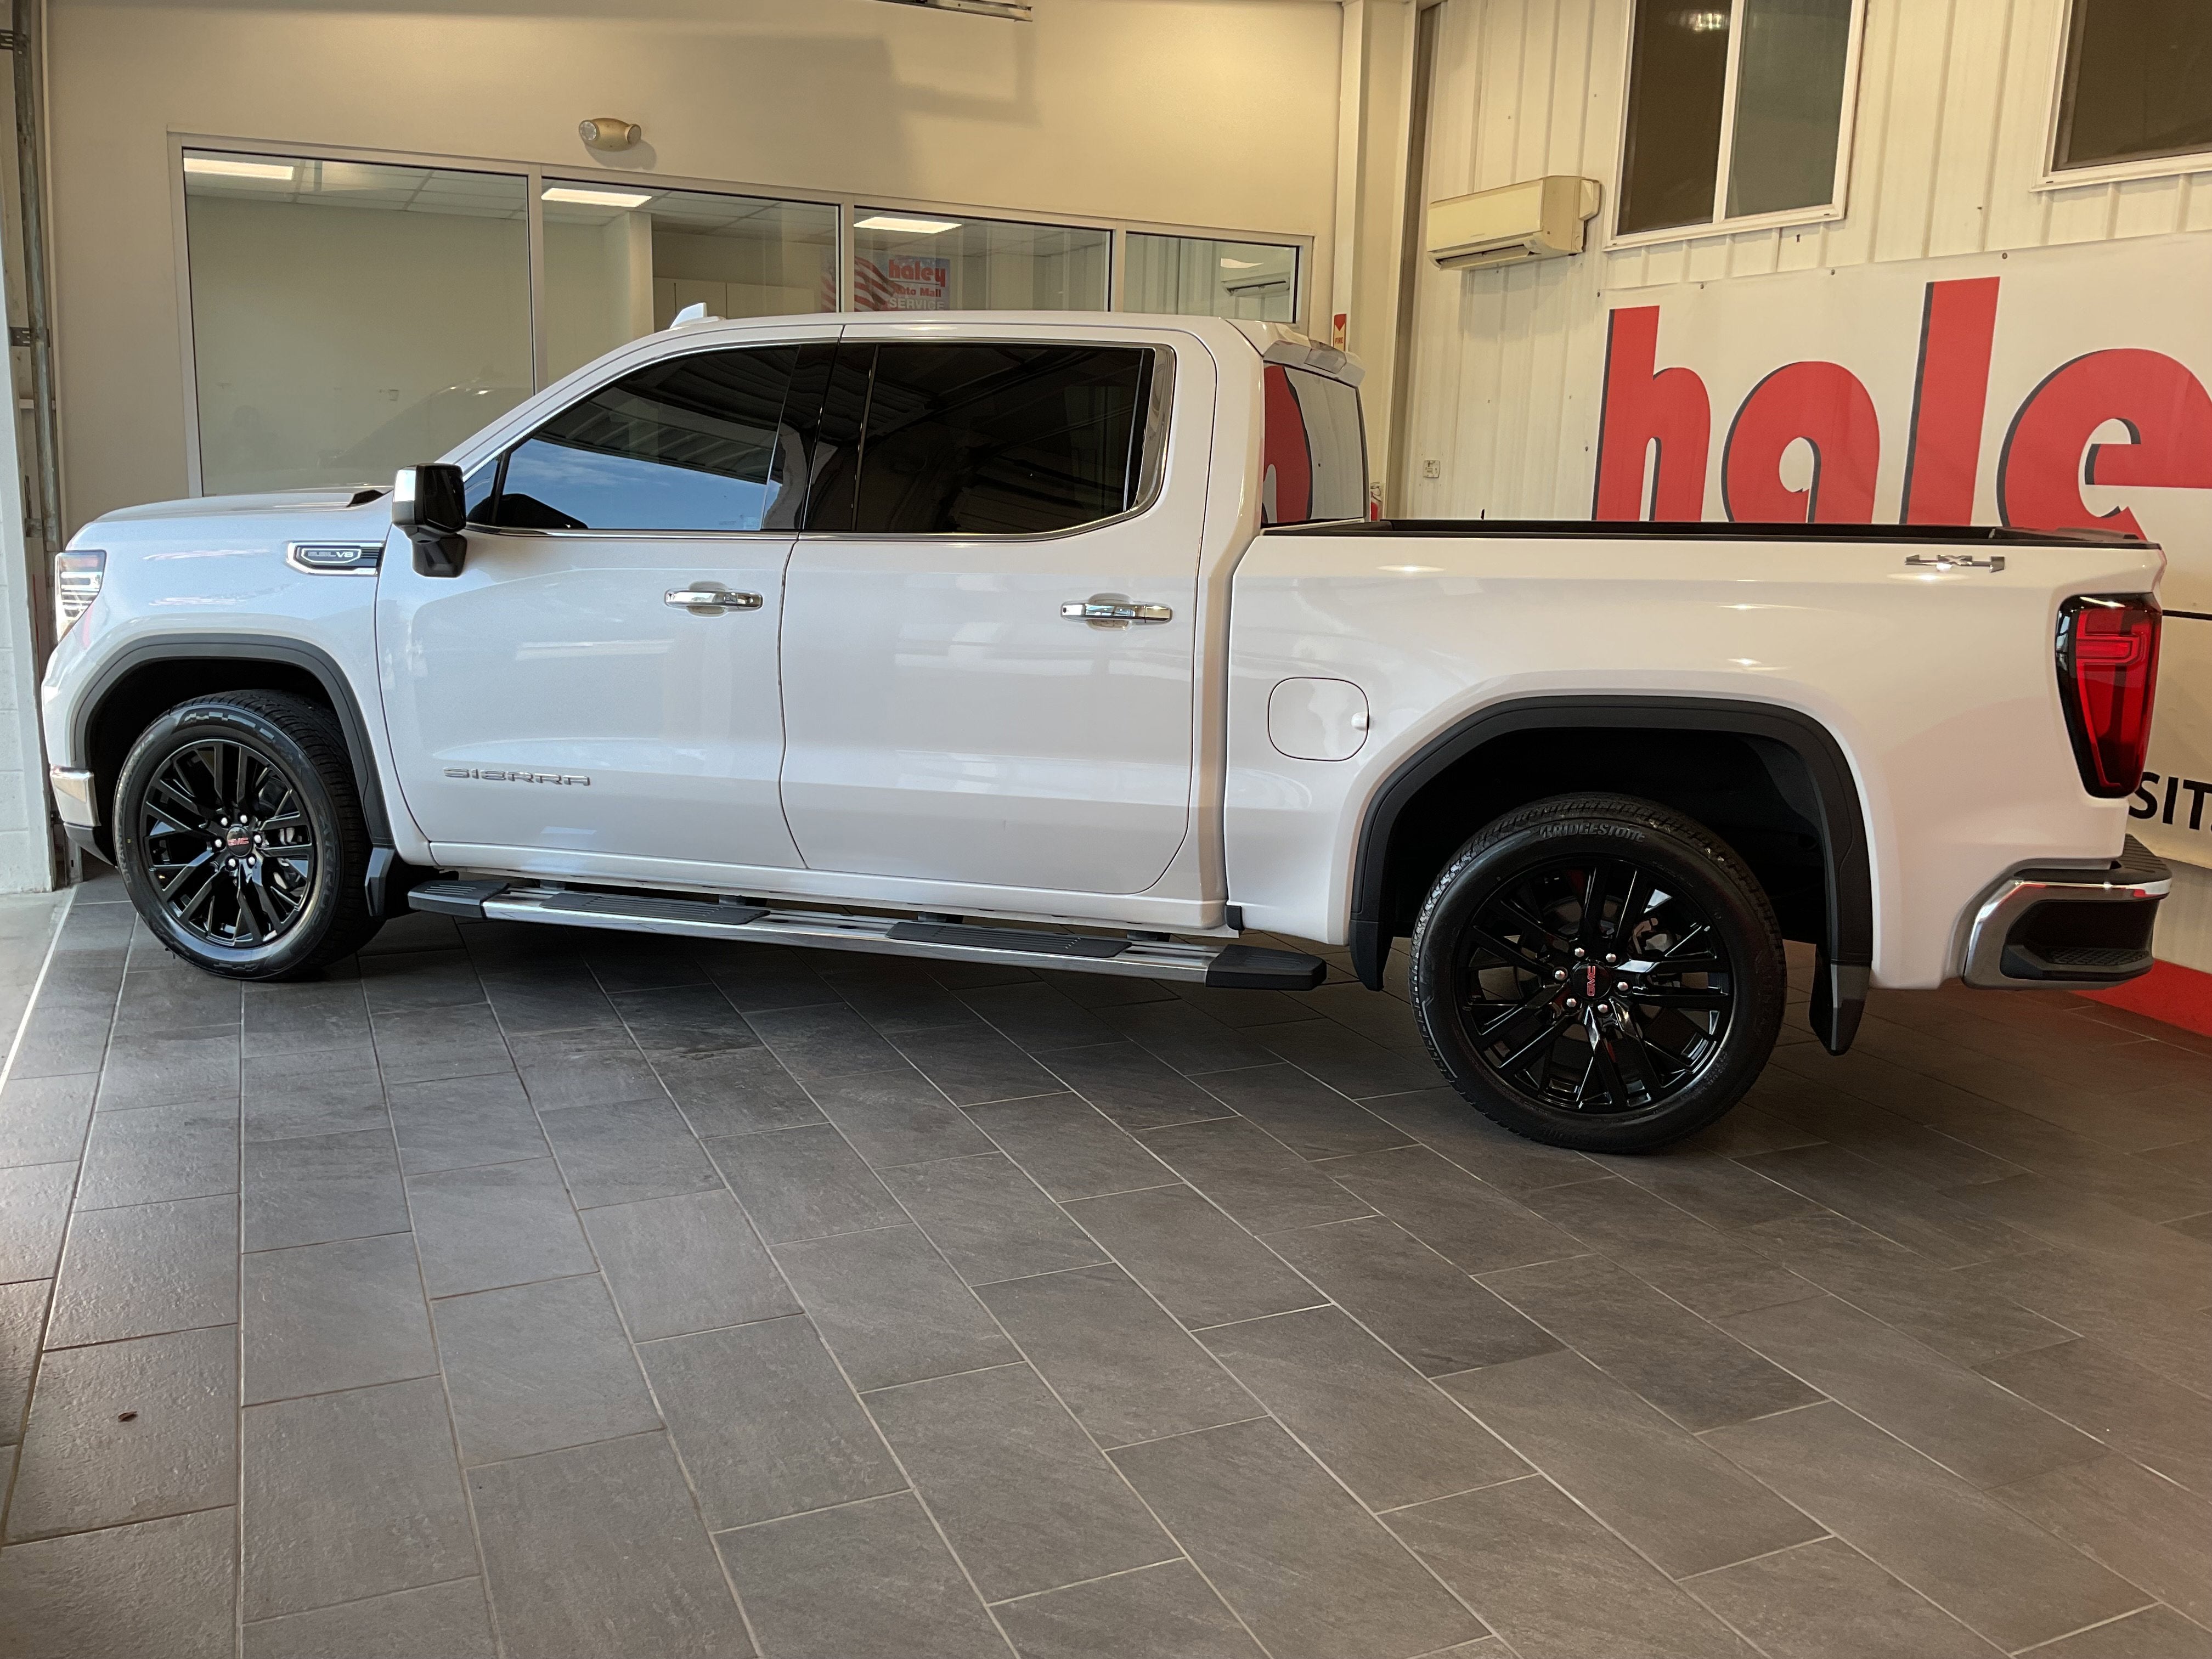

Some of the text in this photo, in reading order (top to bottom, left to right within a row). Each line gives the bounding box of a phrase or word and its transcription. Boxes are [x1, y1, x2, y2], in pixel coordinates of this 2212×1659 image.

[889, 259, 946, 287] haley
[920, 287, 941, 297] Mall
[889, 297, 945, 311] SERVICE
[1592, 276, 2212, 540] hale
[443, 768, 591, 786] SIERRA
[228, 837, 249, 846] GMC
[1587, 966, 1596, 996] GMC
